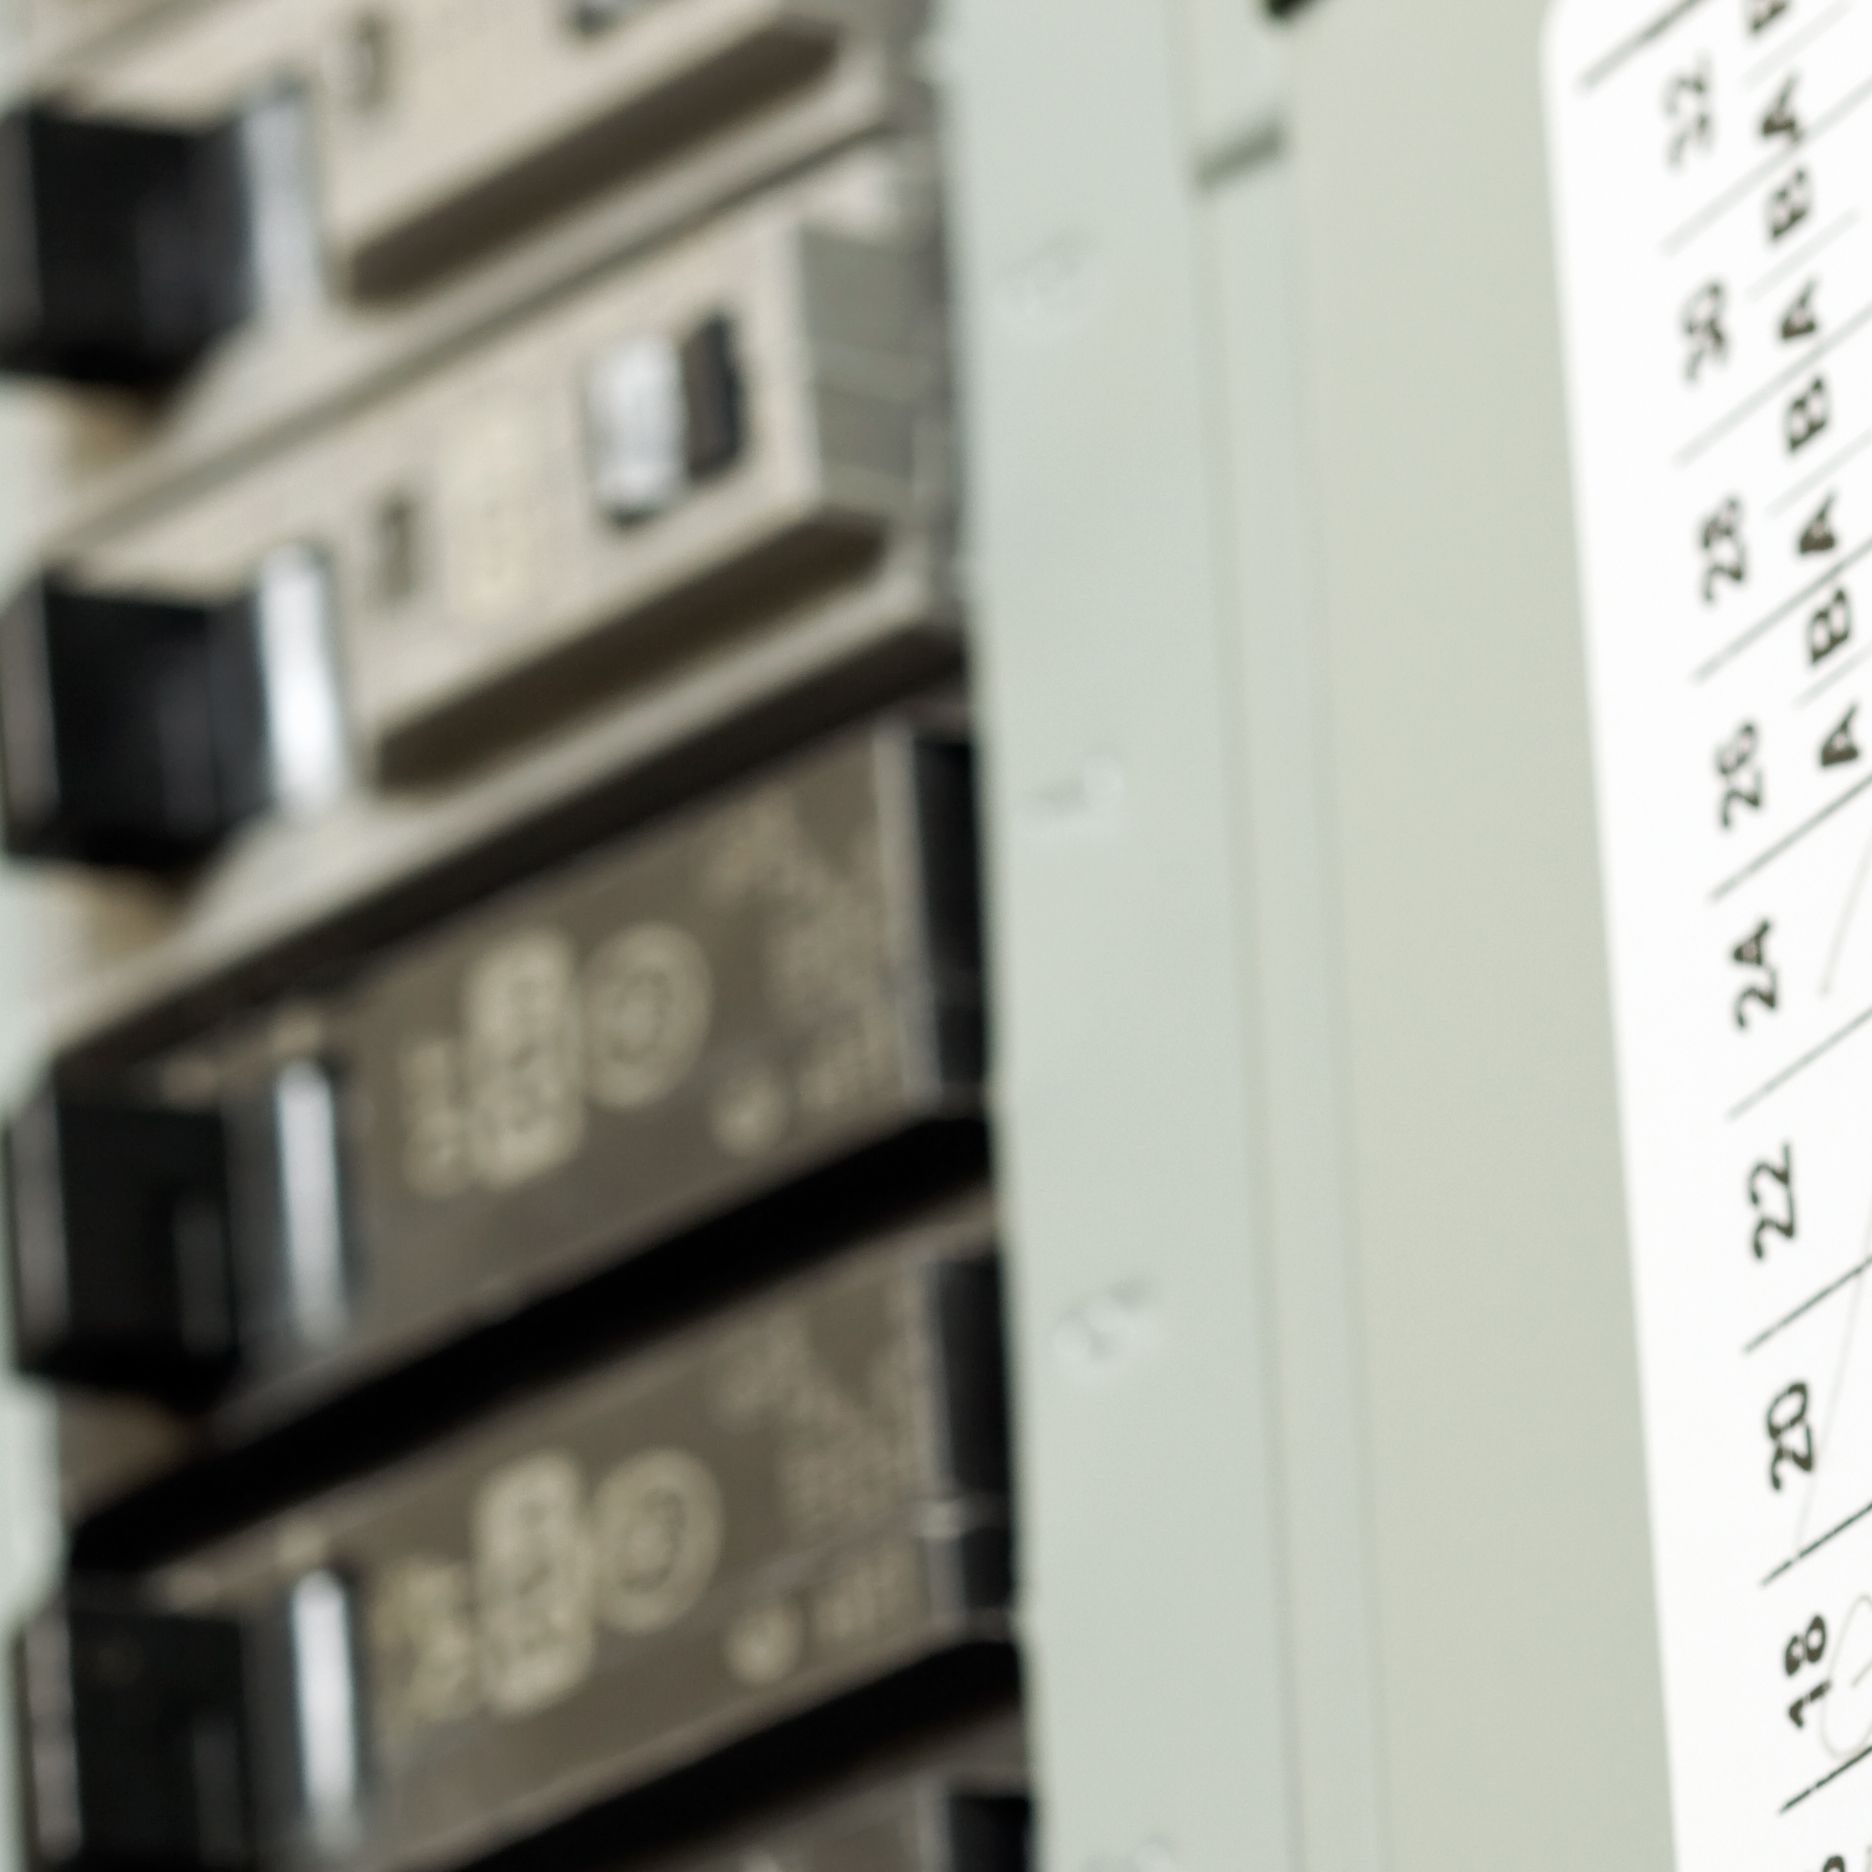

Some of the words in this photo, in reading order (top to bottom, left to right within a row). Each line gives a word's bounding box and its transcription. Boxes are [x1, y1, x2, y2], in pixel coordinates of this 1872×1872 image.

[1756, 68, 1806, 147] A
[1765, 165, 1812, 243] B
[1777, 275, 1820, 346] A
[1784, 372, 1831, 455] B
[1797, 490, 1839, 559] A
[1807, 584, 1853, 668] B
[1714, 720, 1763, 829] 26
[1819, 703, 1860, 769] A
[1726, 918, 1779, 1031] 24
[1747, 1140, 1799, 1262] 22
[1765, 1380, 1814, 1491] 20
[1784, 1613, 1832, 1727] 18
